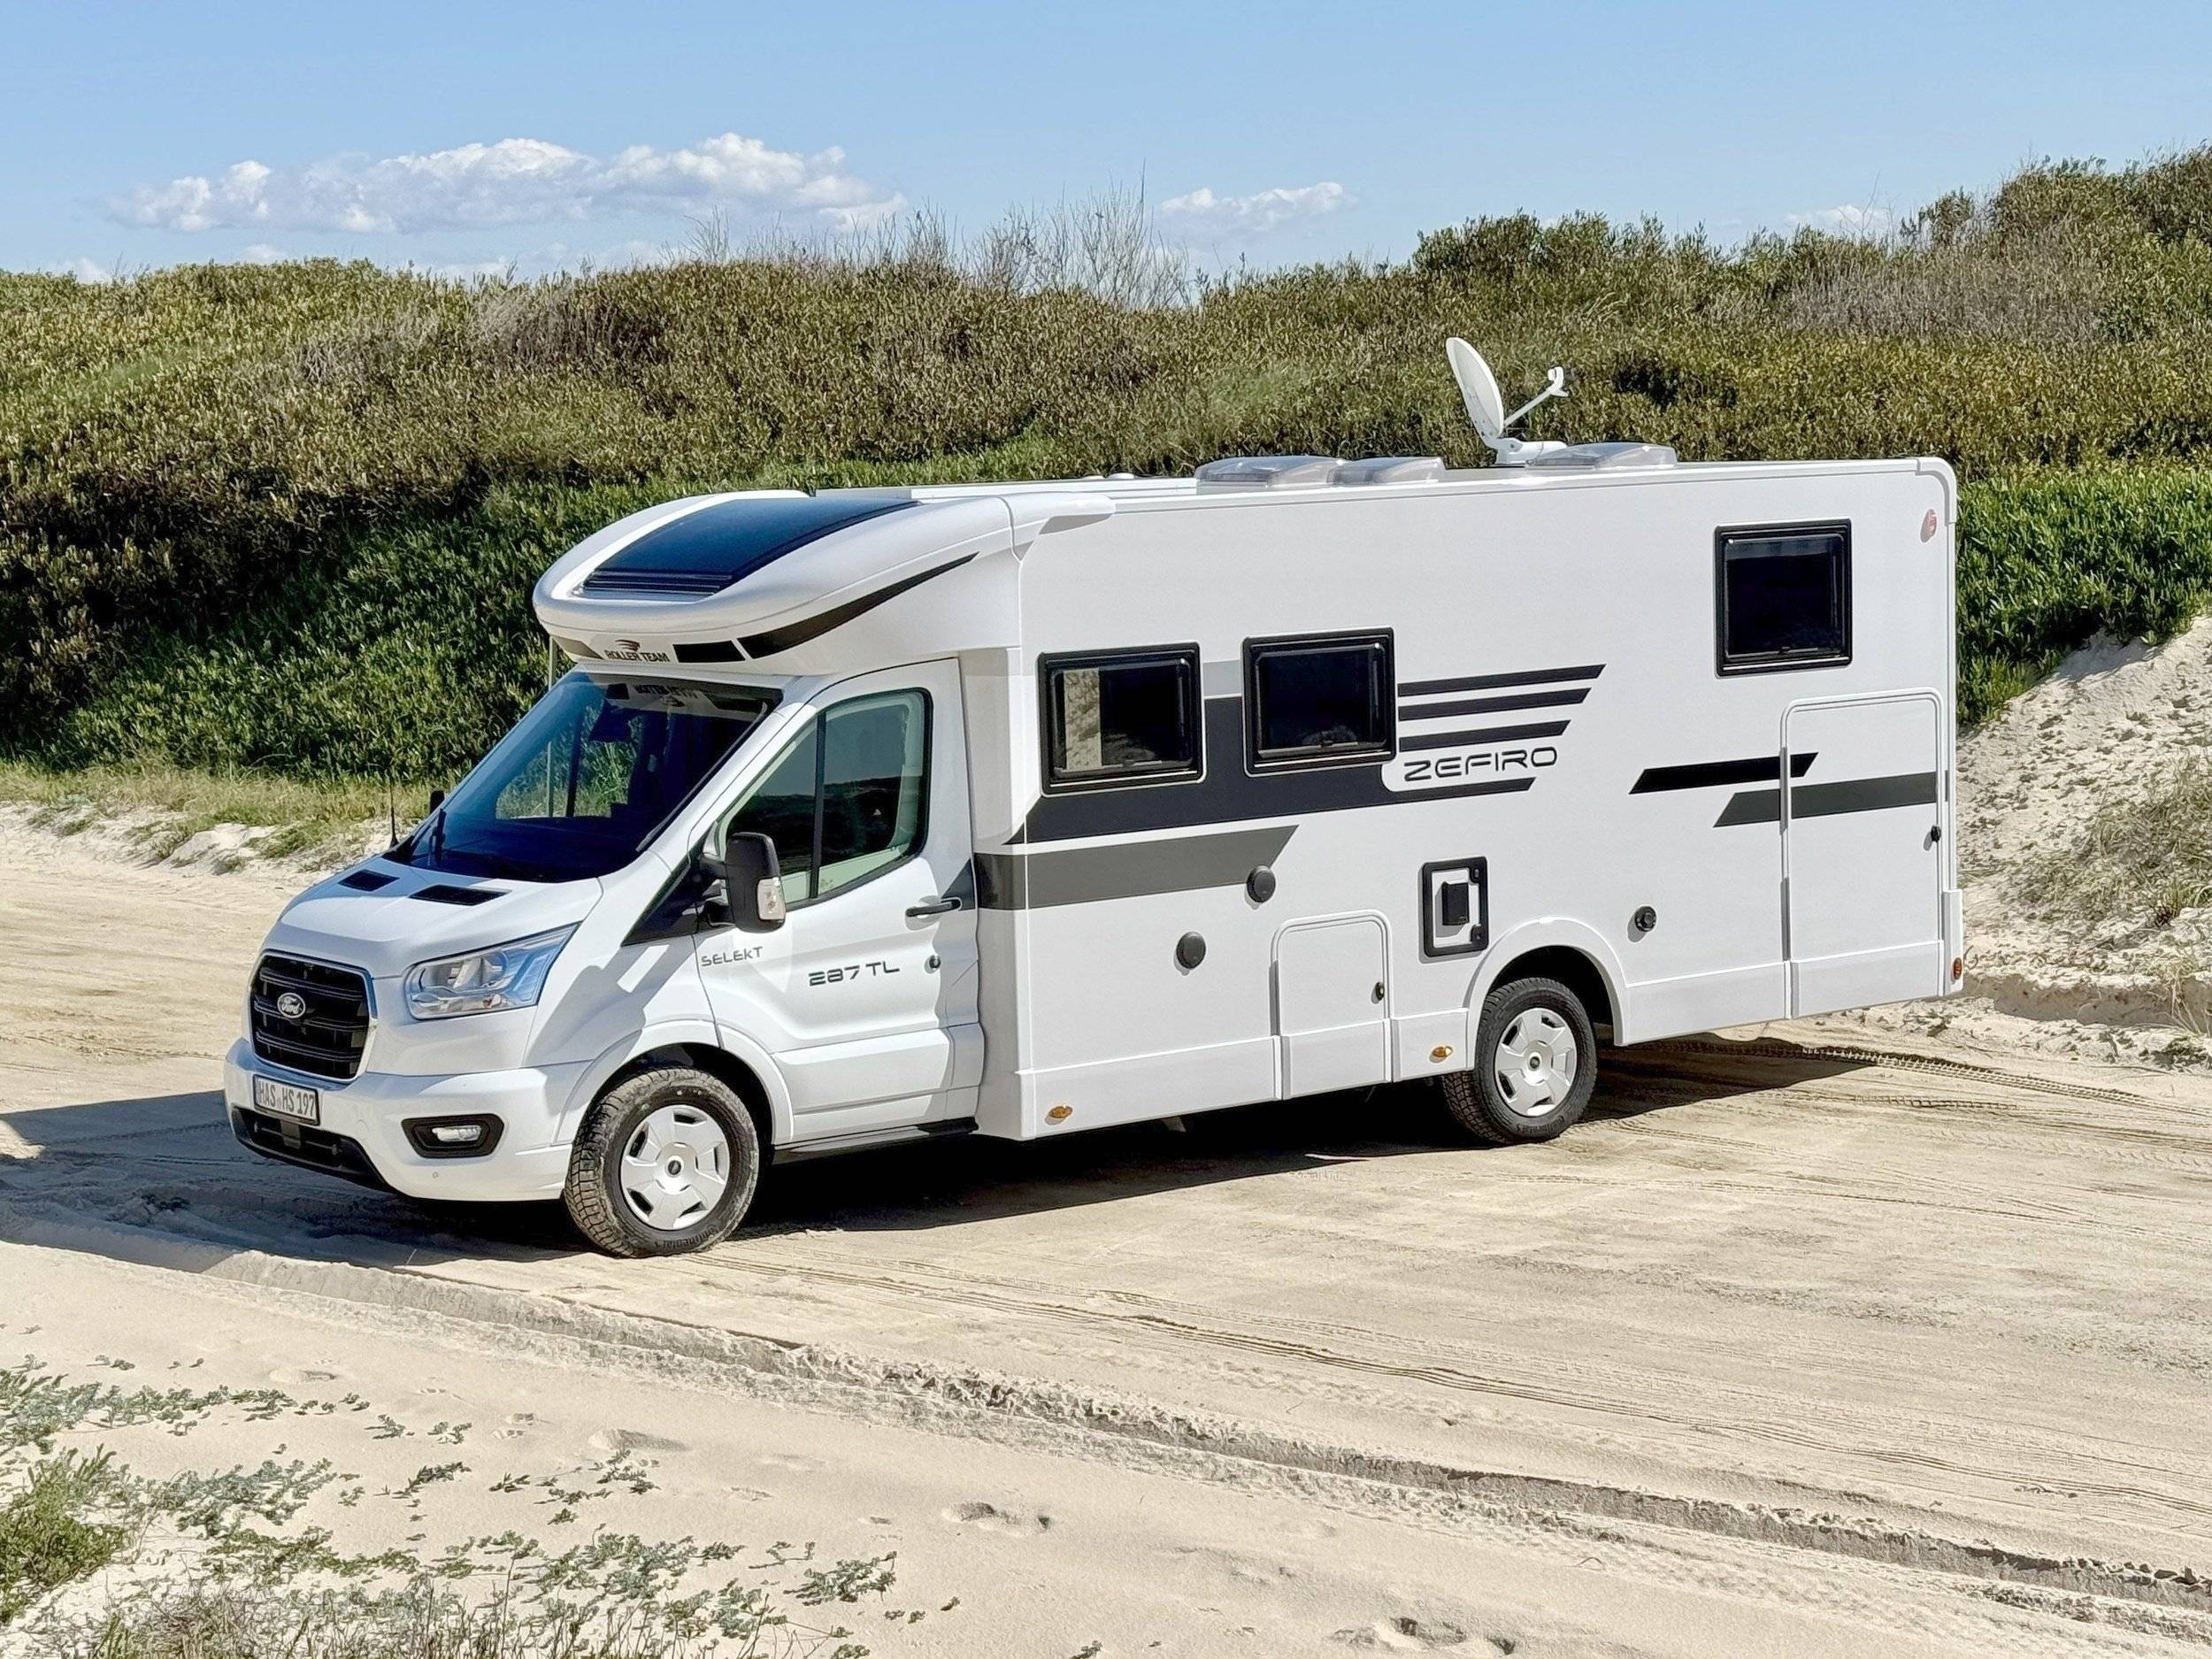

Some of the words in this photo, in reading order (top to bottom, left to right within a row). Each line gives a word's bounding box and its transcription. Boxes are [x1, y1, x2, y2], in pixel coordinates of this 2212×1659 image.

[604, 649, 643, 662] ROLLER
[639, 652, 671, 663] TEAM
[1404, 747, 1557, 781] ZEFIRO
[701, 946, 763, 967] SELEKT
[808, 965, 861, 987] 287
[865, 961, 901, 978] TL
[281, 995, 303, 1015] Ford
[258, 1079, 276, 1108] HAS
[281, 1087, 295, 1111] HS
[297, 1090, 315, 1118] 197
